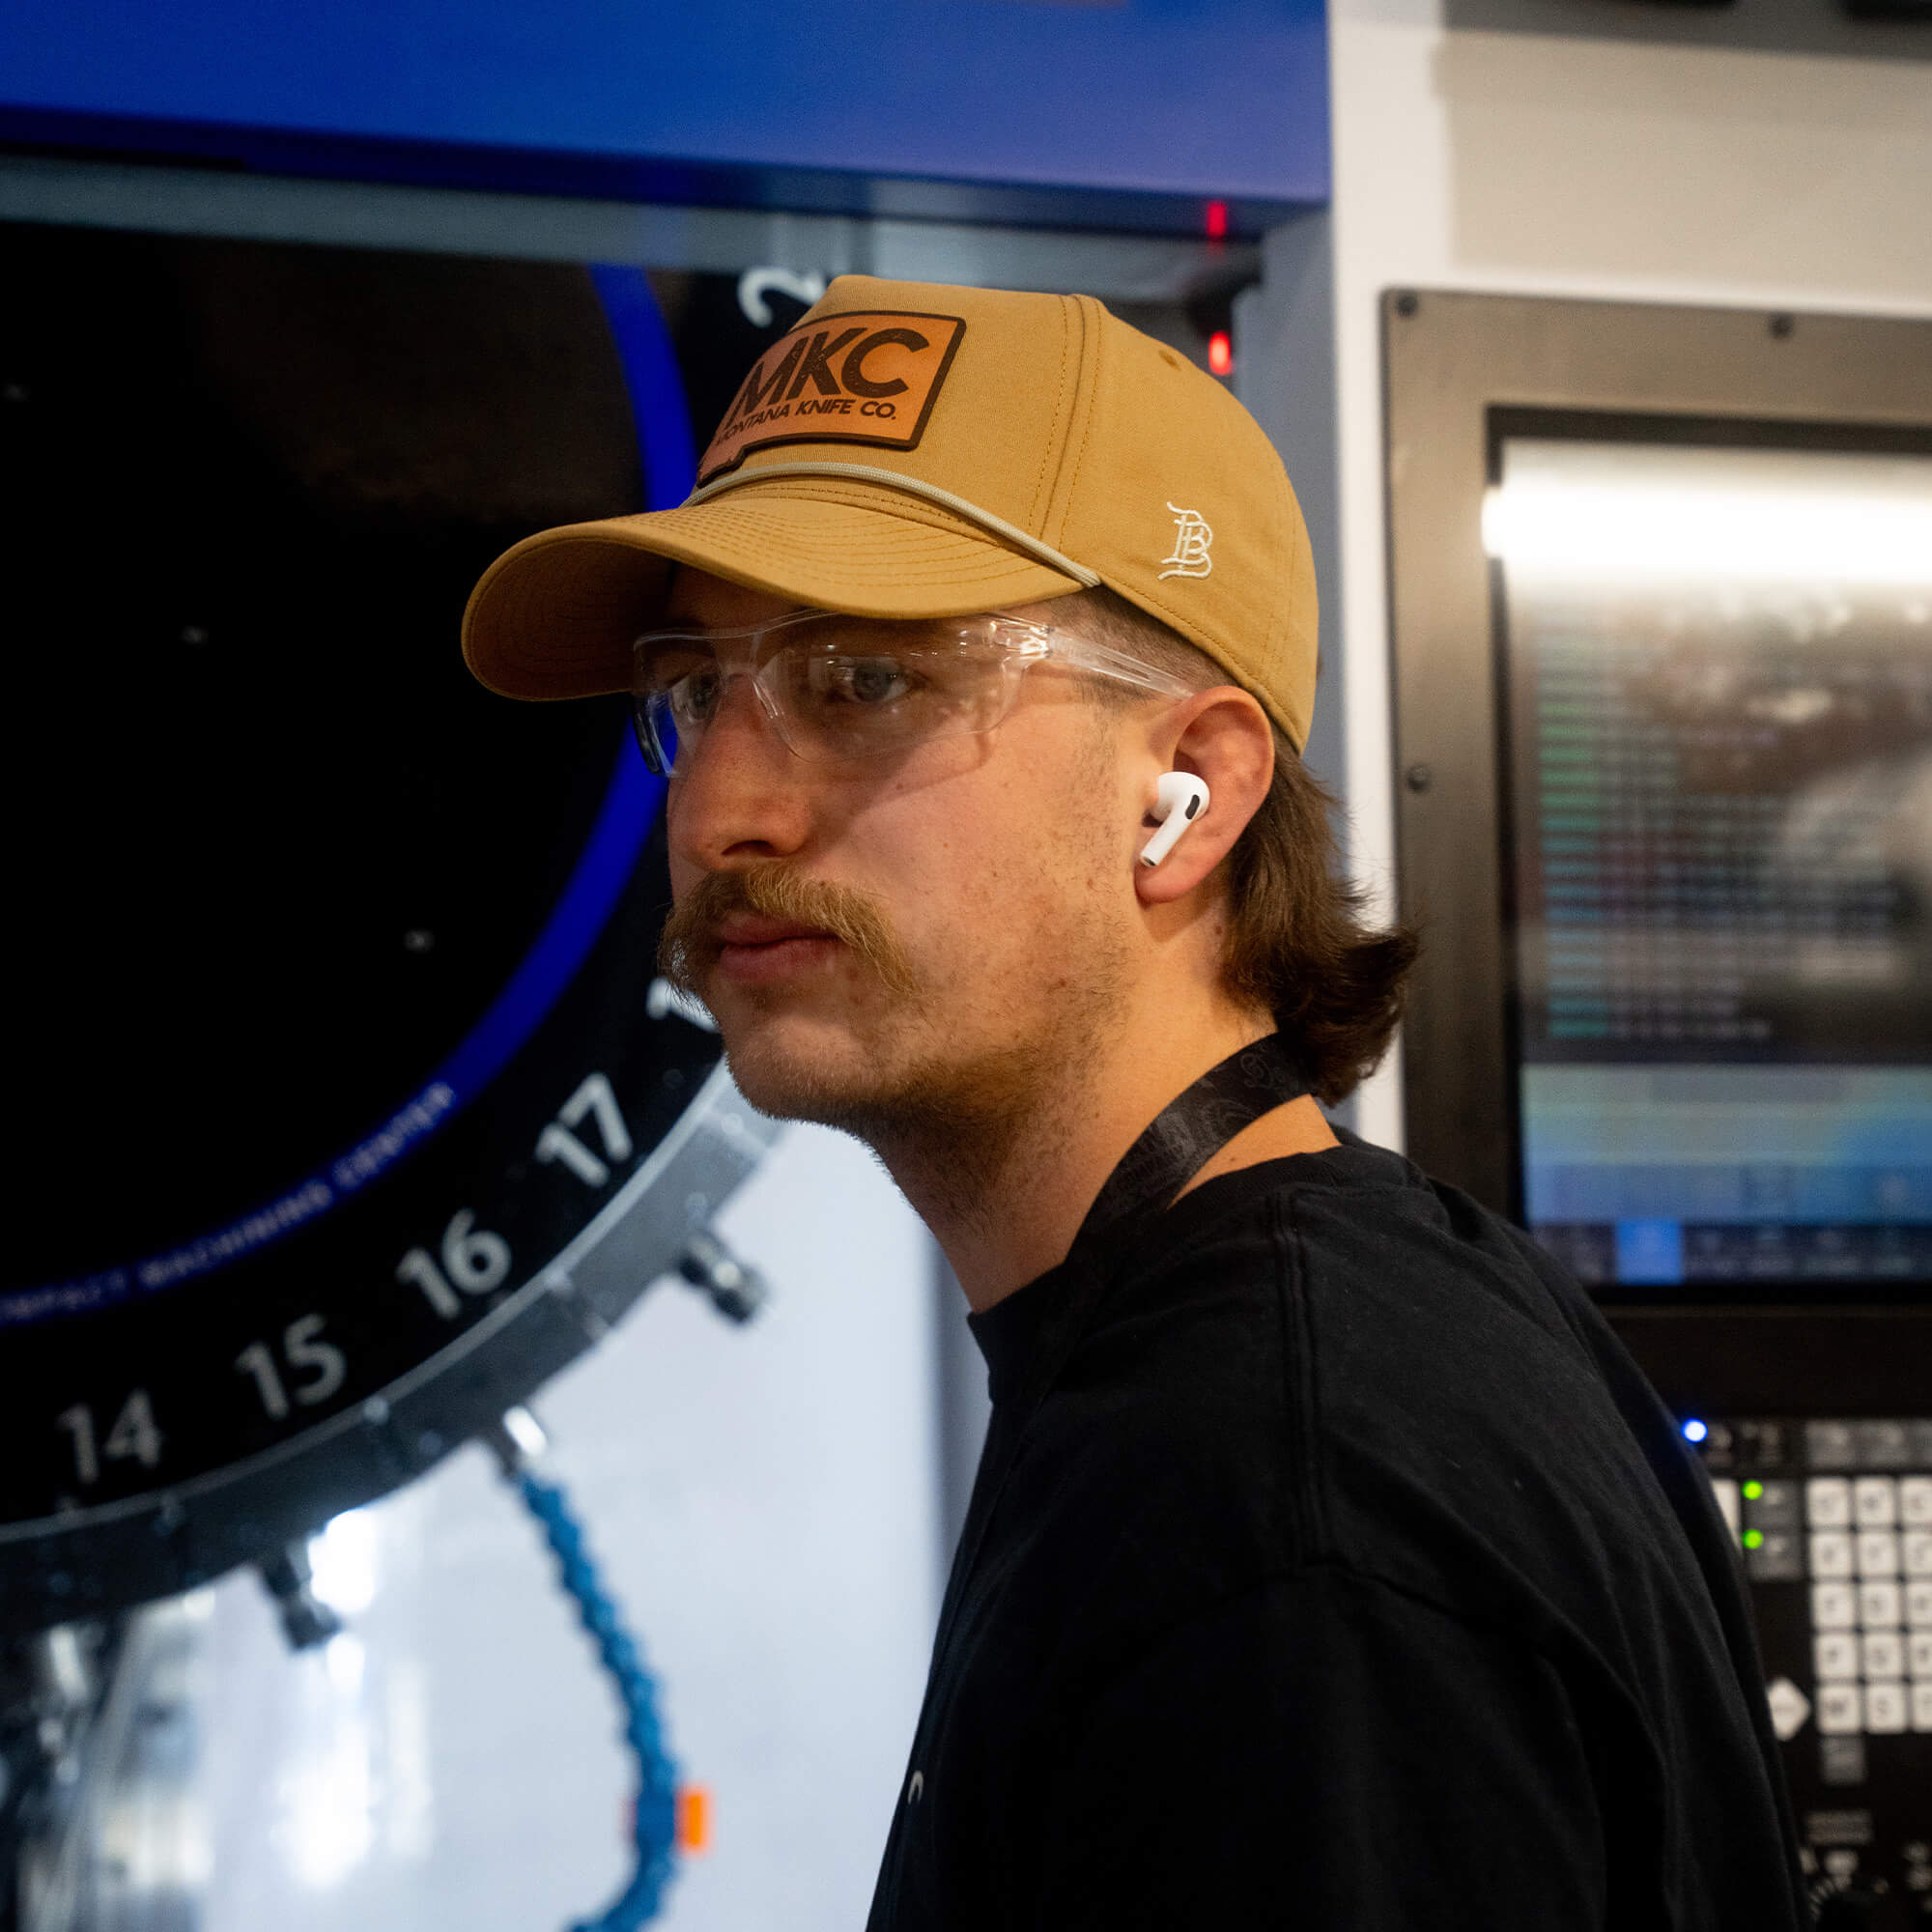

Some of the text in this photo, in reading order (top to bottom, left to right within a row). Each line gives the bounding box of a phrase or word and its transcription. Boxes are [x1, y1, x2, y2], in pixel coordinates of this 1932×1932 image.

[722, 327, 930, 431] MKC
[795, 398, 856, 416] KNIFE
[860, 401, 896, 420] CO.
[536, 1073, 633, 1187] 17
[396, 1208, 512, 1320] 16
[236, 1313, 346, 1420] 15
[56, 1388, 163, 1485] 14
